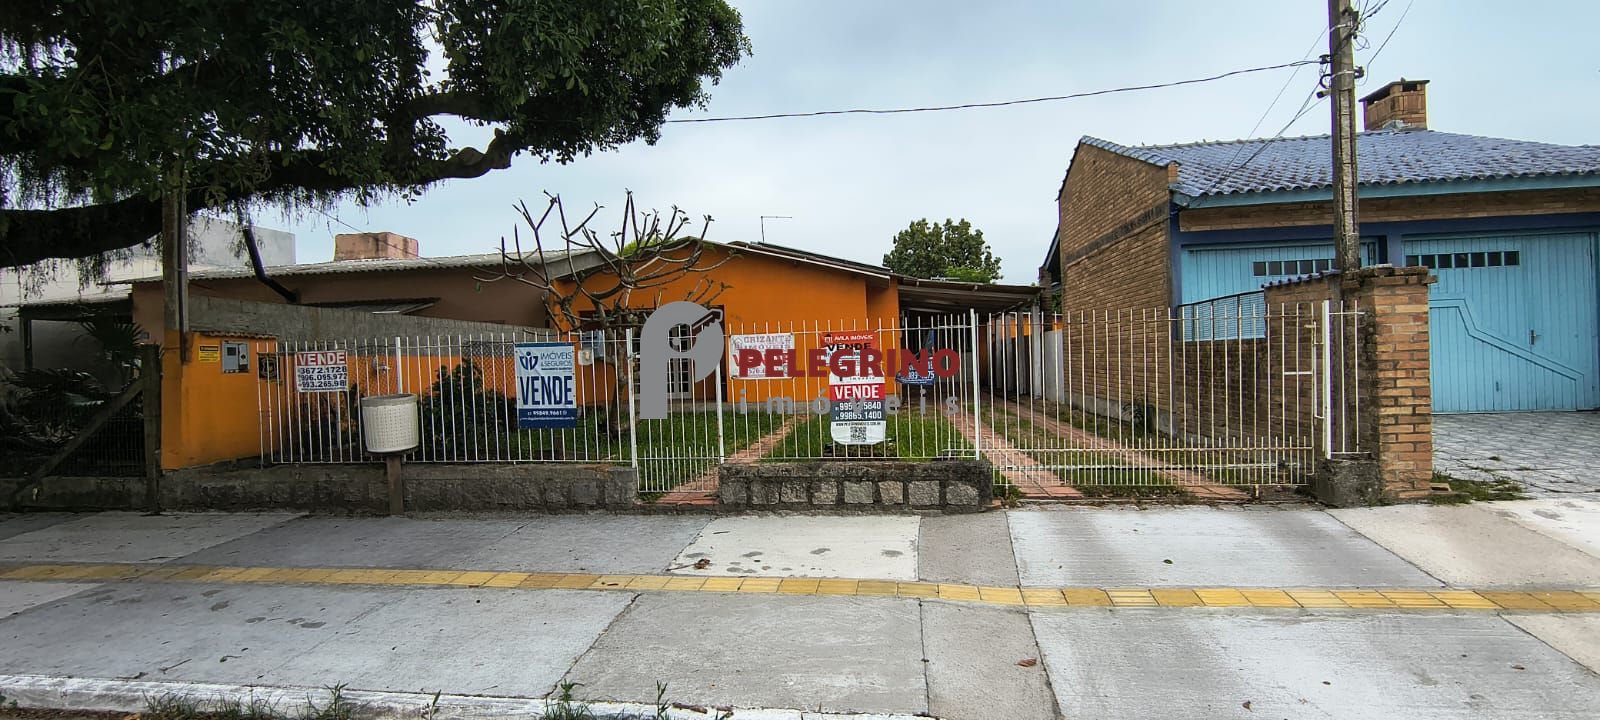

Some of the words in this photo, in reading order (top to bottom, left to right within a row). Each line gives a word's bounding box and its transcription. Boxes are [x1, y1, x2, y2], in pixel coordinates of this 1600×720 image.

[825, 342, 872, 351] VENDE
[298, 353, 345, 365] VENDE
[540, 351, 572, 360] IMÓVEIS
[519, 375, 573, 405] VENDE
[834, 384, 880, 399] VENDE
